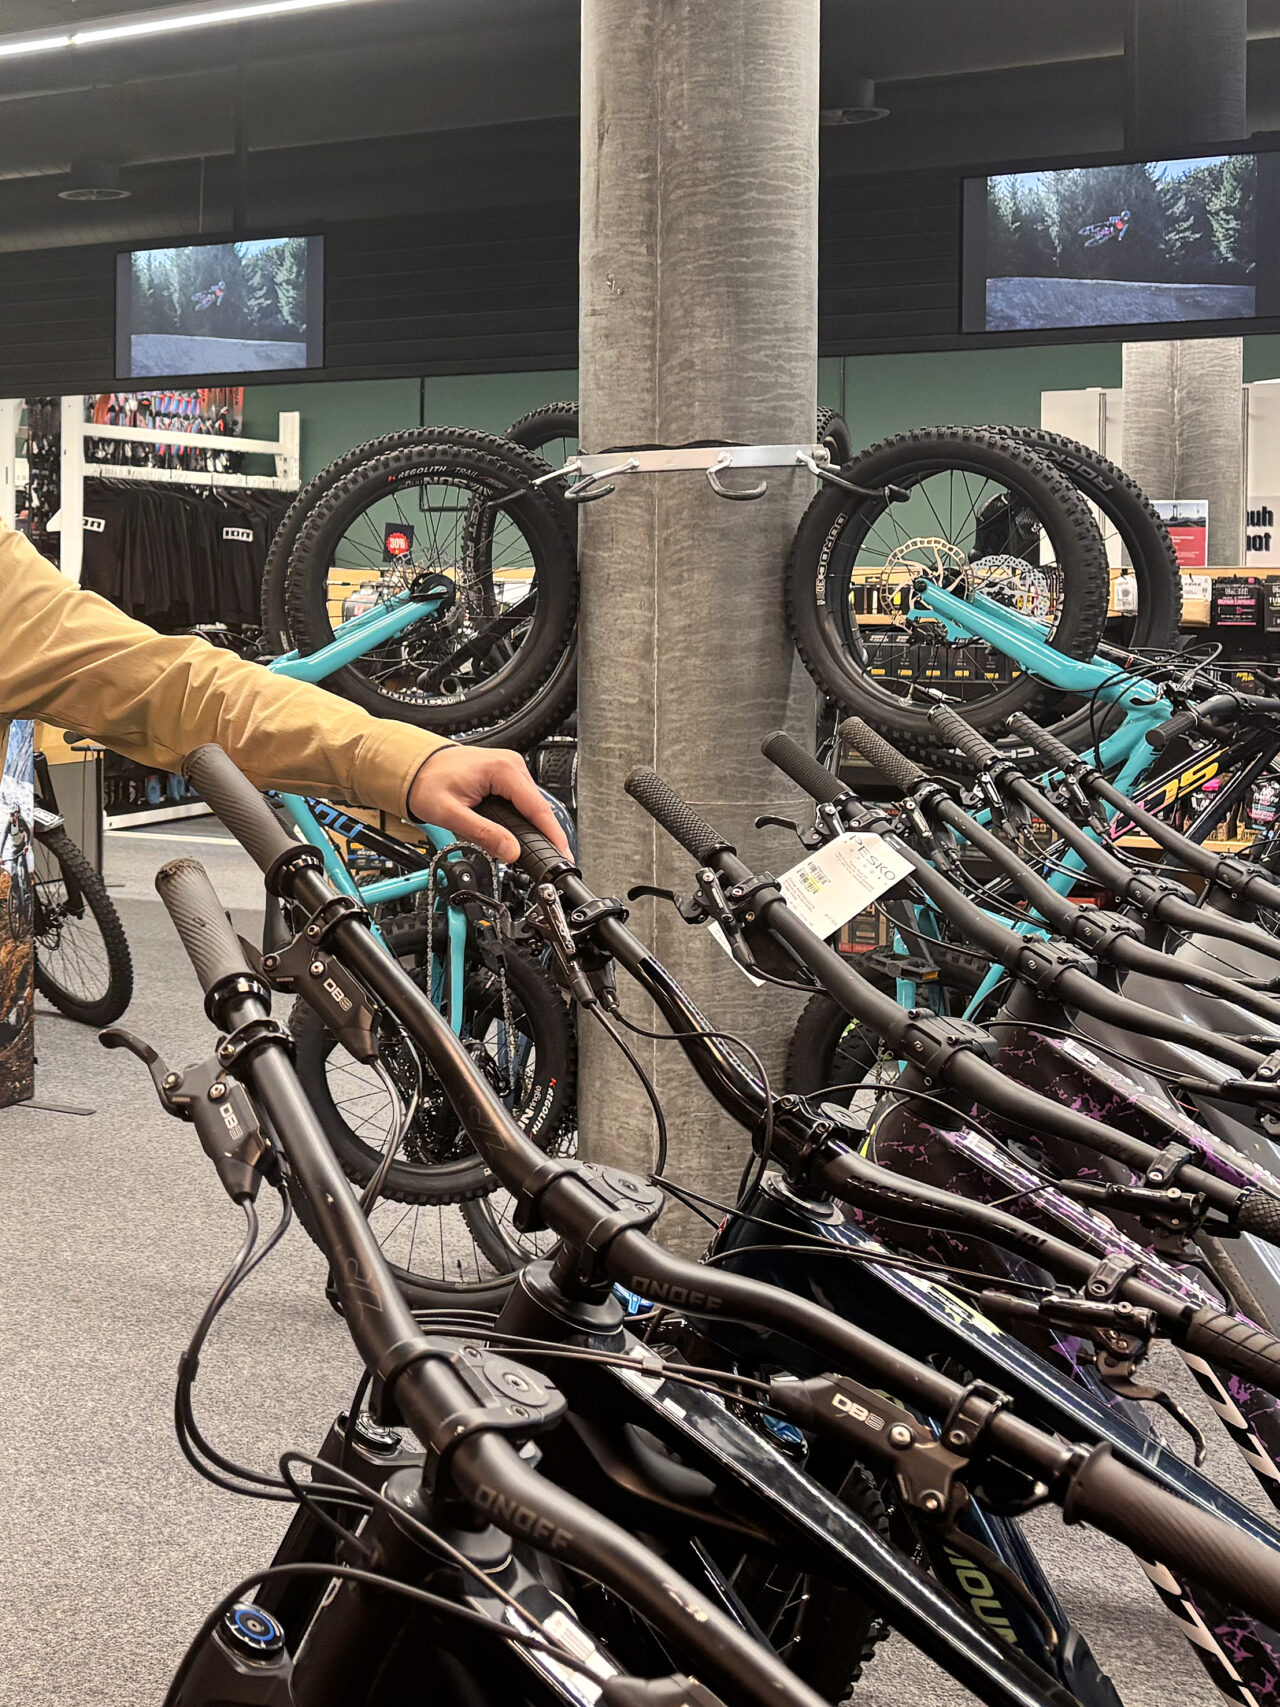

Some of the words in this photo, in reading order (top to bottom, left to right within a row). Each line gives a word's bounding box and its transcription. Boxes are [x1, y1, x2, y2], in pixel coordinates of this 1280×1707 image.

[397, 465, 447, 480] REGOLITH
[389, 537, 406, 549] 30%
[849, 834, 896, 881] PESKO
[531, 1087, 554, 1135] REGOLITH
[475, 1484, 575, 1549] ONOFF
